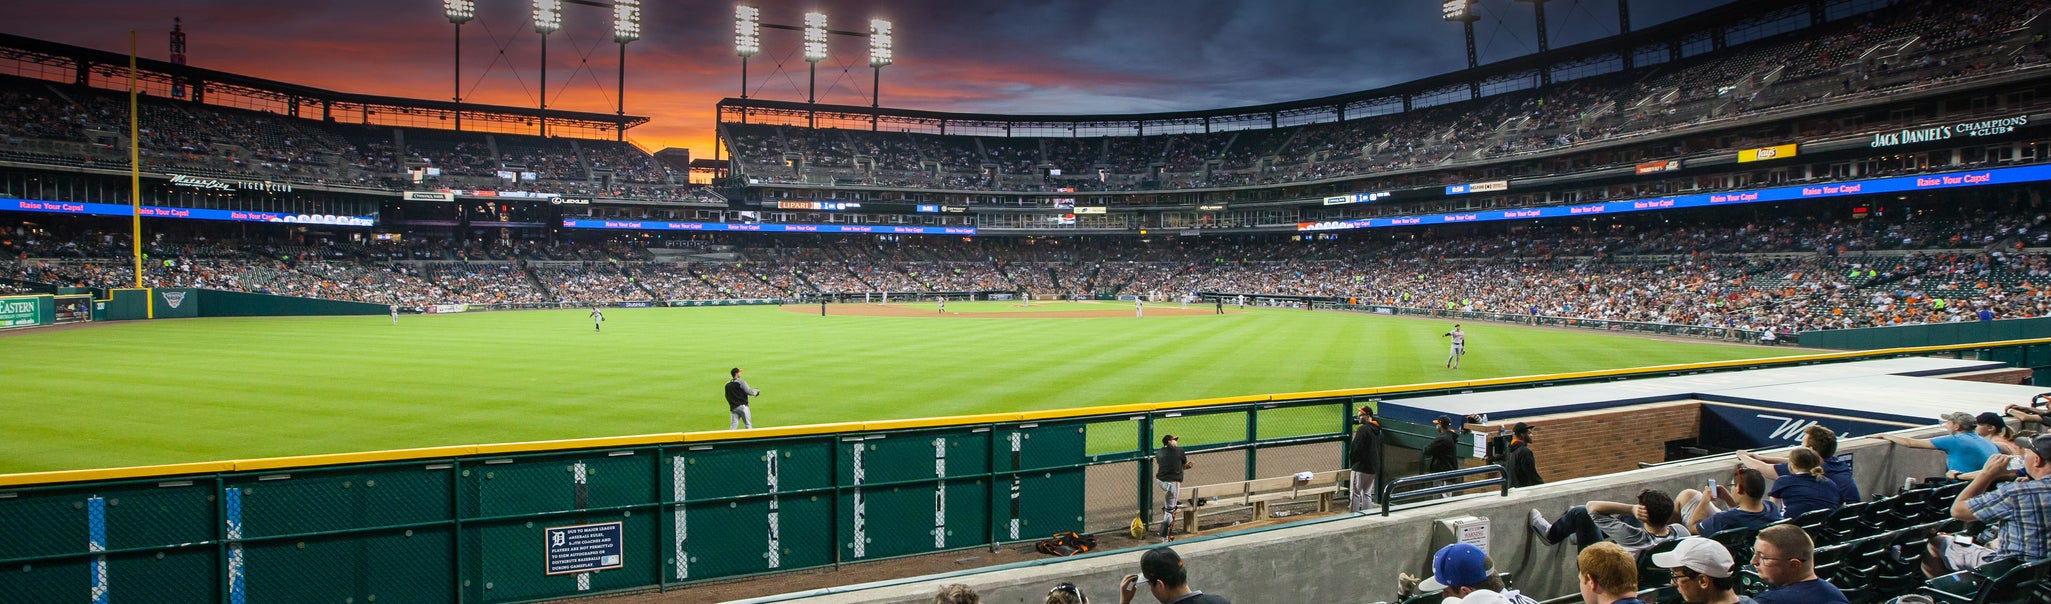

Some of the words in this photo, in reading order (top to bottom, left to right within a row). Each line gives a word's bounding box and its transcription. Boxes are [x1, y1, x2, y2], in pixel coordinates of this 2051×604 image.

[1956, 115, 2027, 133] CHAMPIONS
[1871, 133, 1899, 148] JACK
[1902, 125, 1952, 144] DANIEL'S
[1977, 126, 2006, 137] CLUB
[1917, 177, 1940, 187] Raise
[1942, 176, 1961, 185] Your
[1964, 173, 1990, 185] Caps!
[238, 181, 265, 191] TIGER
[272, 184, 292, 192] CLUB
[1802, 187, 1822, 196] Raise
[1823, 186, 1838, 194] Your
[1840, 184, 1860, 193] Caps!
[1660, 199, 1674, 207] Caps!
[1710, 195, 1726, 203] Raise
[1727, 194, 1740, 202] Your
[1741, 193, 1757, 201] Caps!
[20, 201, 41, 209] Raise
[171, 209, 190, 217] Caps!
